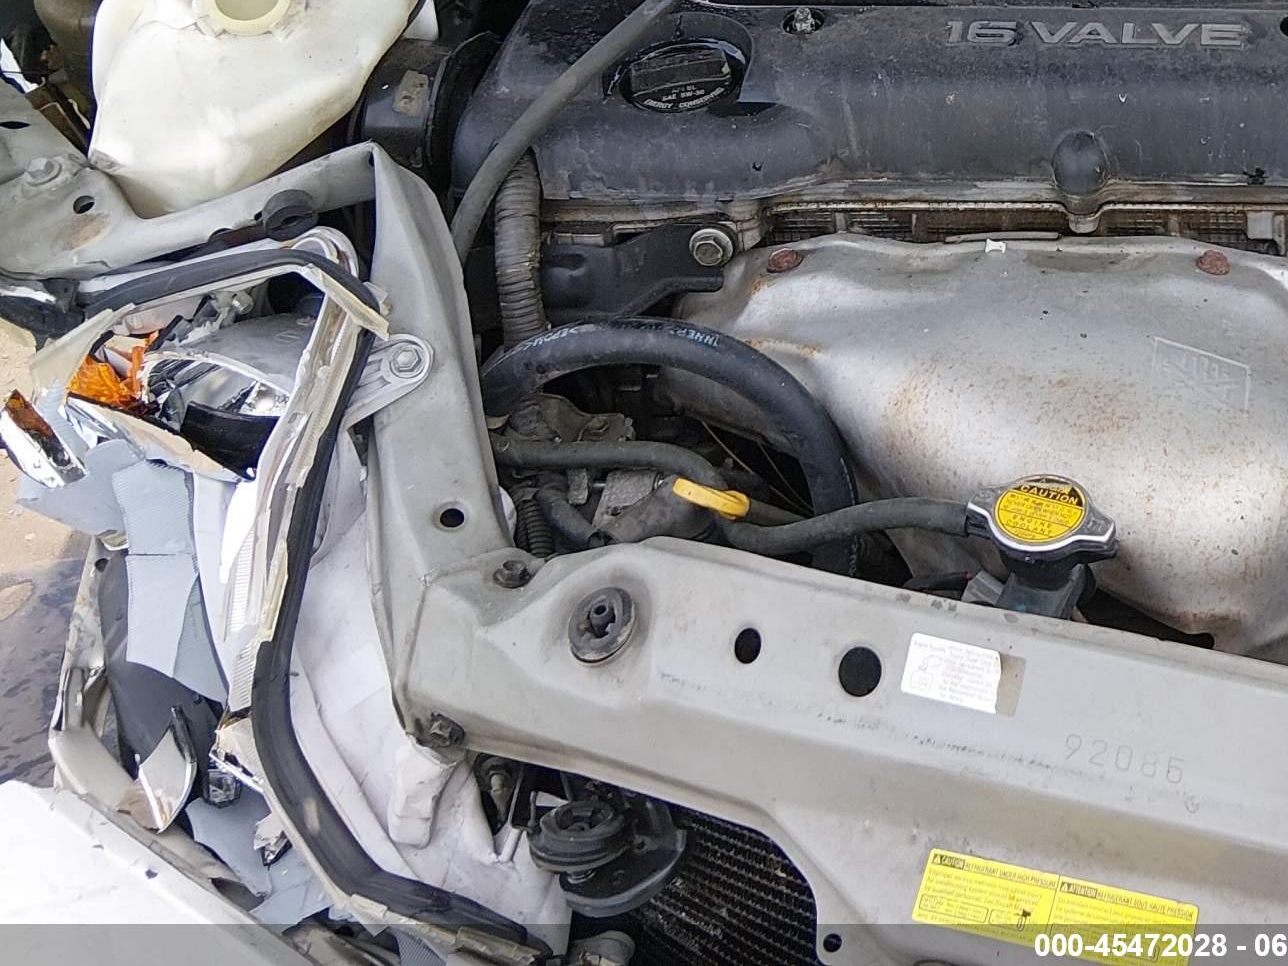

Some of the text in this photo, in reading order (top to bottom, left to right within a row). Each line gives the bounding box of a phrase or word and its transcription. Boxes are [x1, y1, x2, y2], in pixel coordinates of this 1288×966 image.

[945, 20, 1248, 49] 16 VALVE
[1019, 484, 1080, 506] CAUTION
